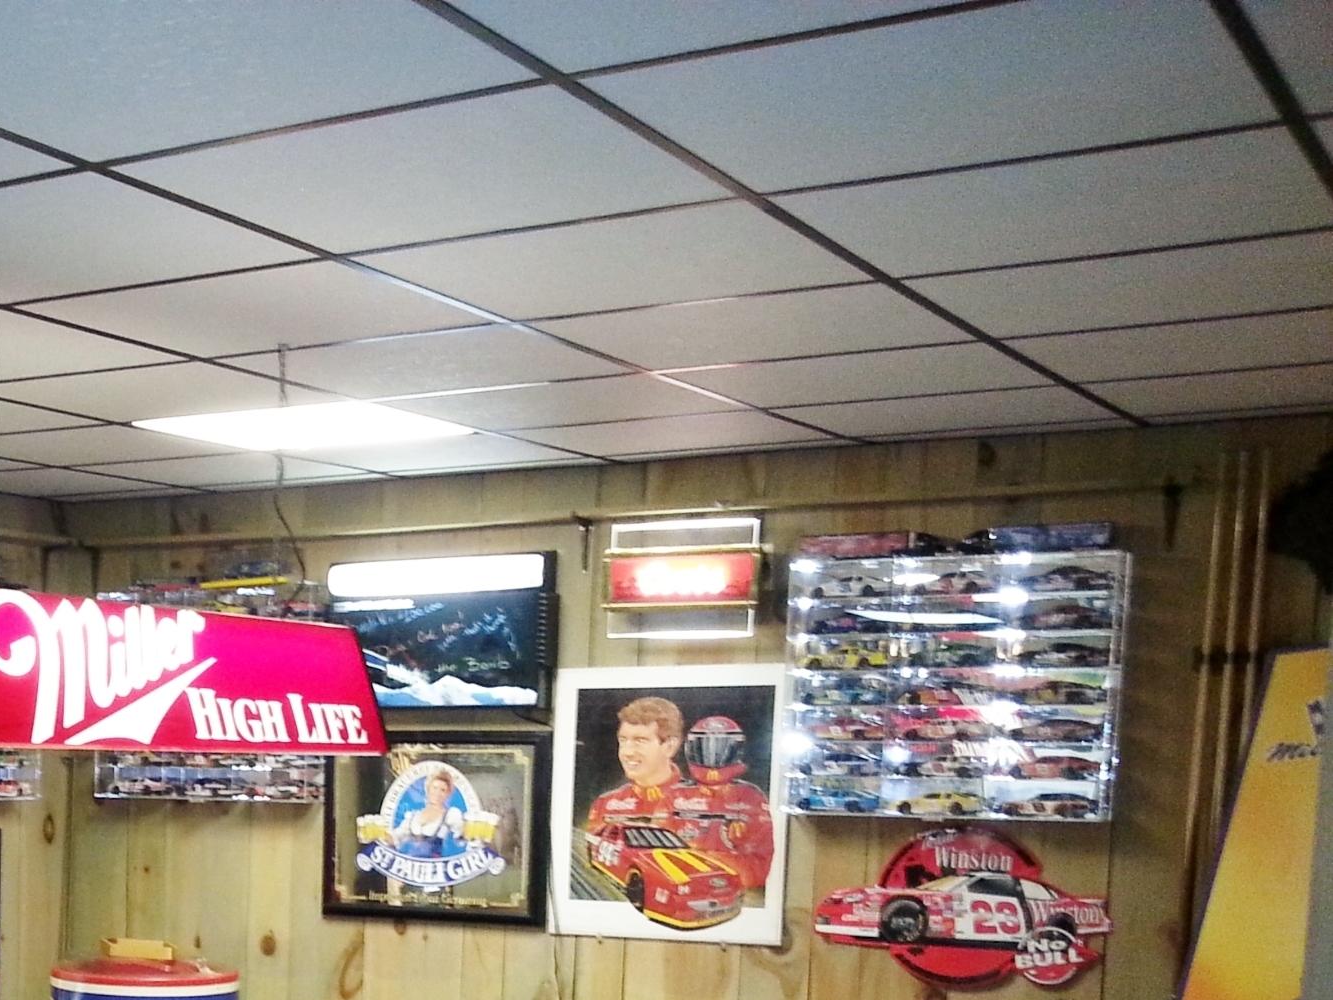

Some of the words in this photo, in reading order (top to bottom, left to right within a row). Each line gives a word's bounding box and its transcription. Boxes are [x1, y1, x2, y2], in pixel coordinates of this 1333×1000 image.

[184, 687, 292, 743] HIGH
[286, 693, 369, 745] LIFE
[447, 848, 494, 880] GIRL
[935, 846, 1013, 872] Winston
[971, 900, 1022, 935] 23
[1015, 948, 1084, 969] BULL
